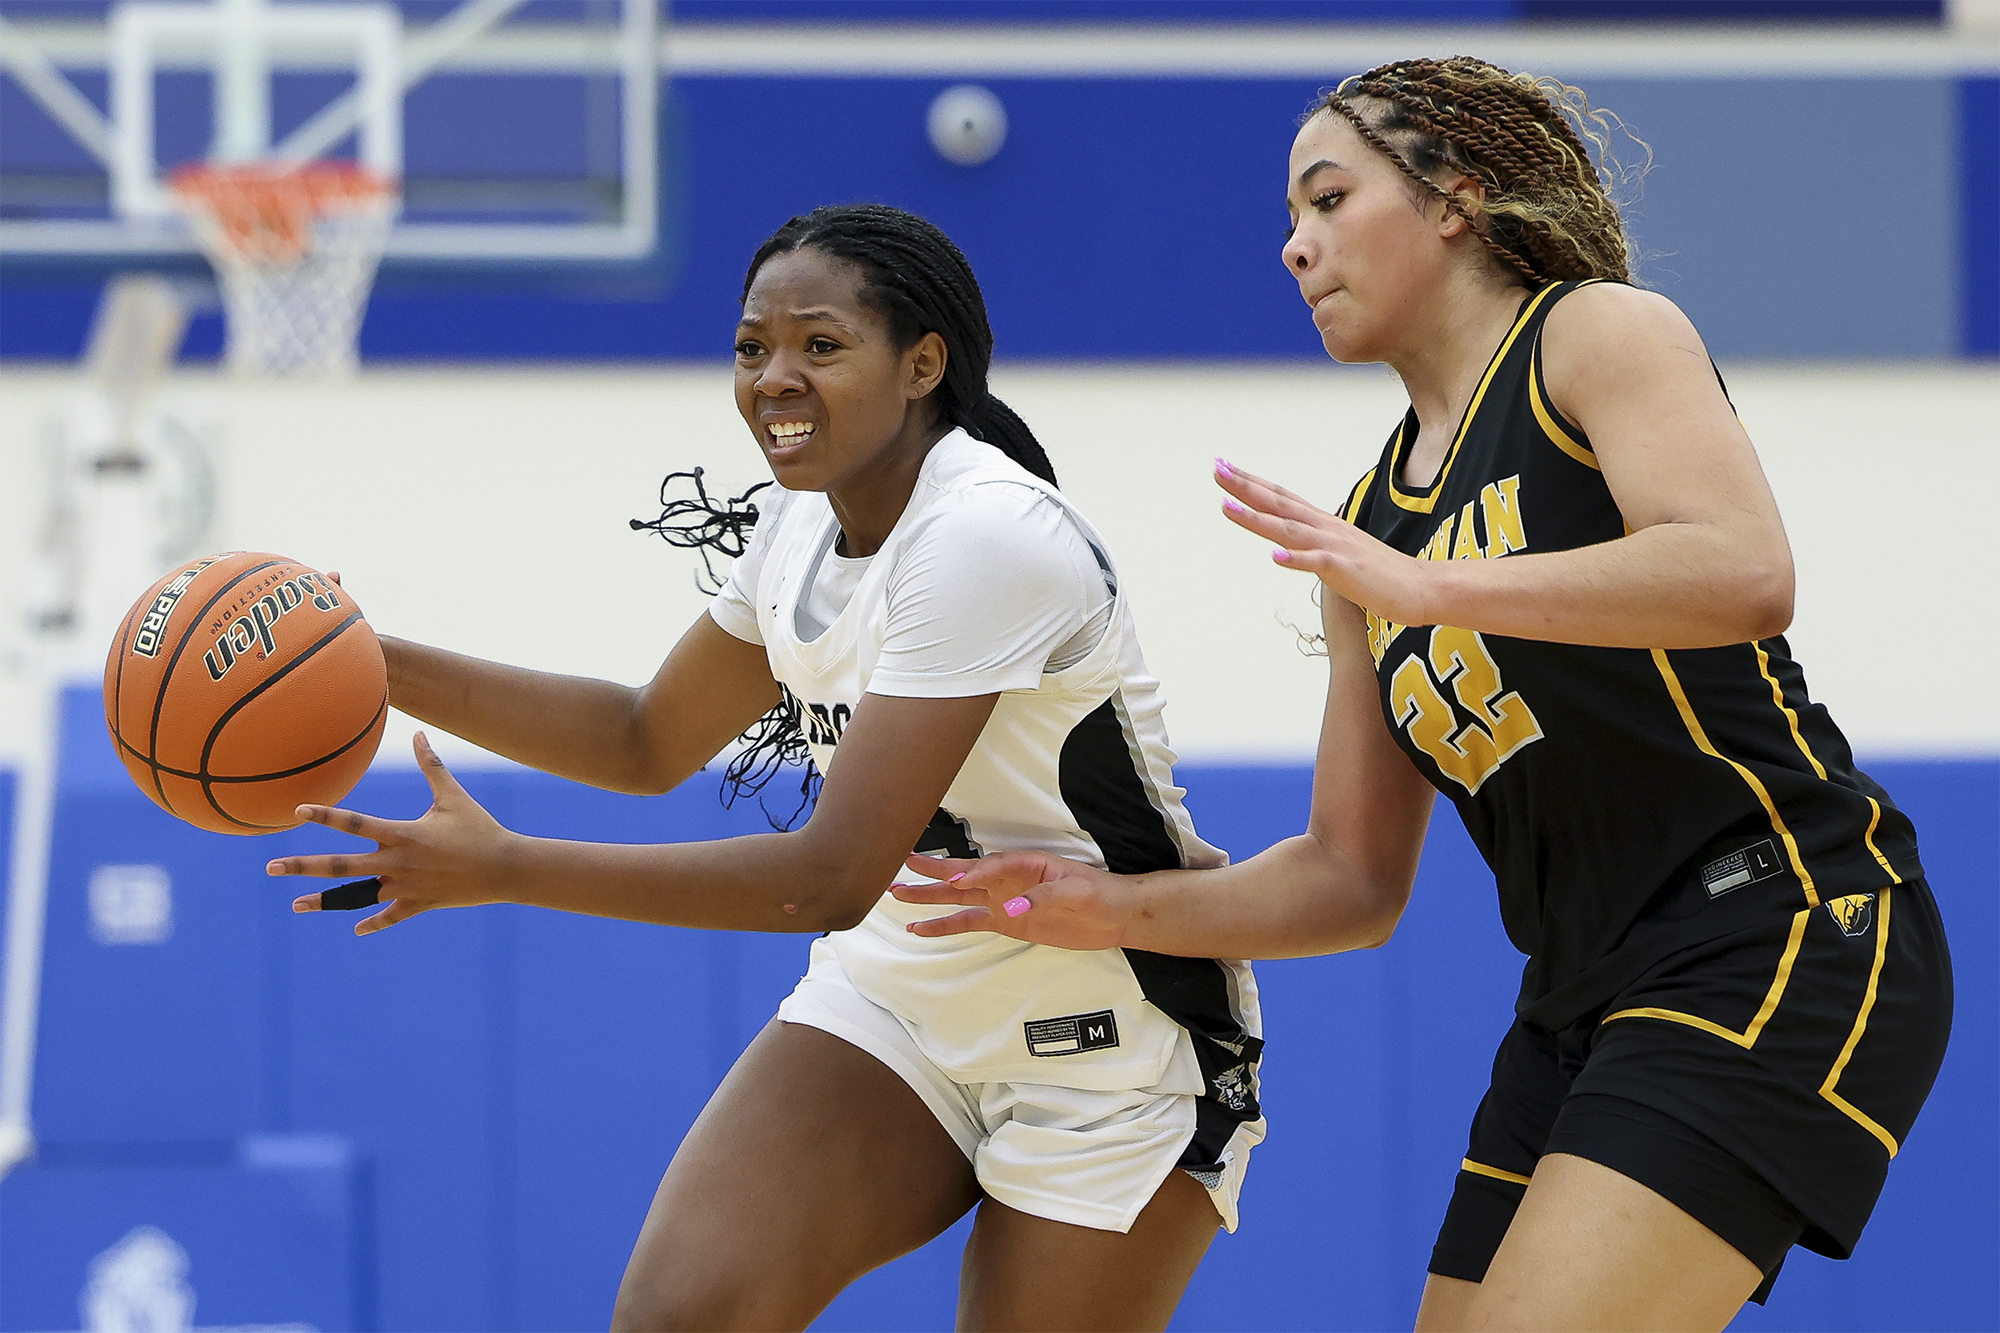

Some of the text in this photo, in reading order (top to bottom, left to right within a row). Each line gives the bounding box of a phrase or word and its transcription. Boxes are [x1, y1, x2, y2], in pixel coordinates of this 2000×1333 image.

[203, 572, 341, 682] Baden
[1391, 625, 1545, 796] 22
[1757, 853, 1769, 868] L
[1088, 1024, 1105, 1041] M
